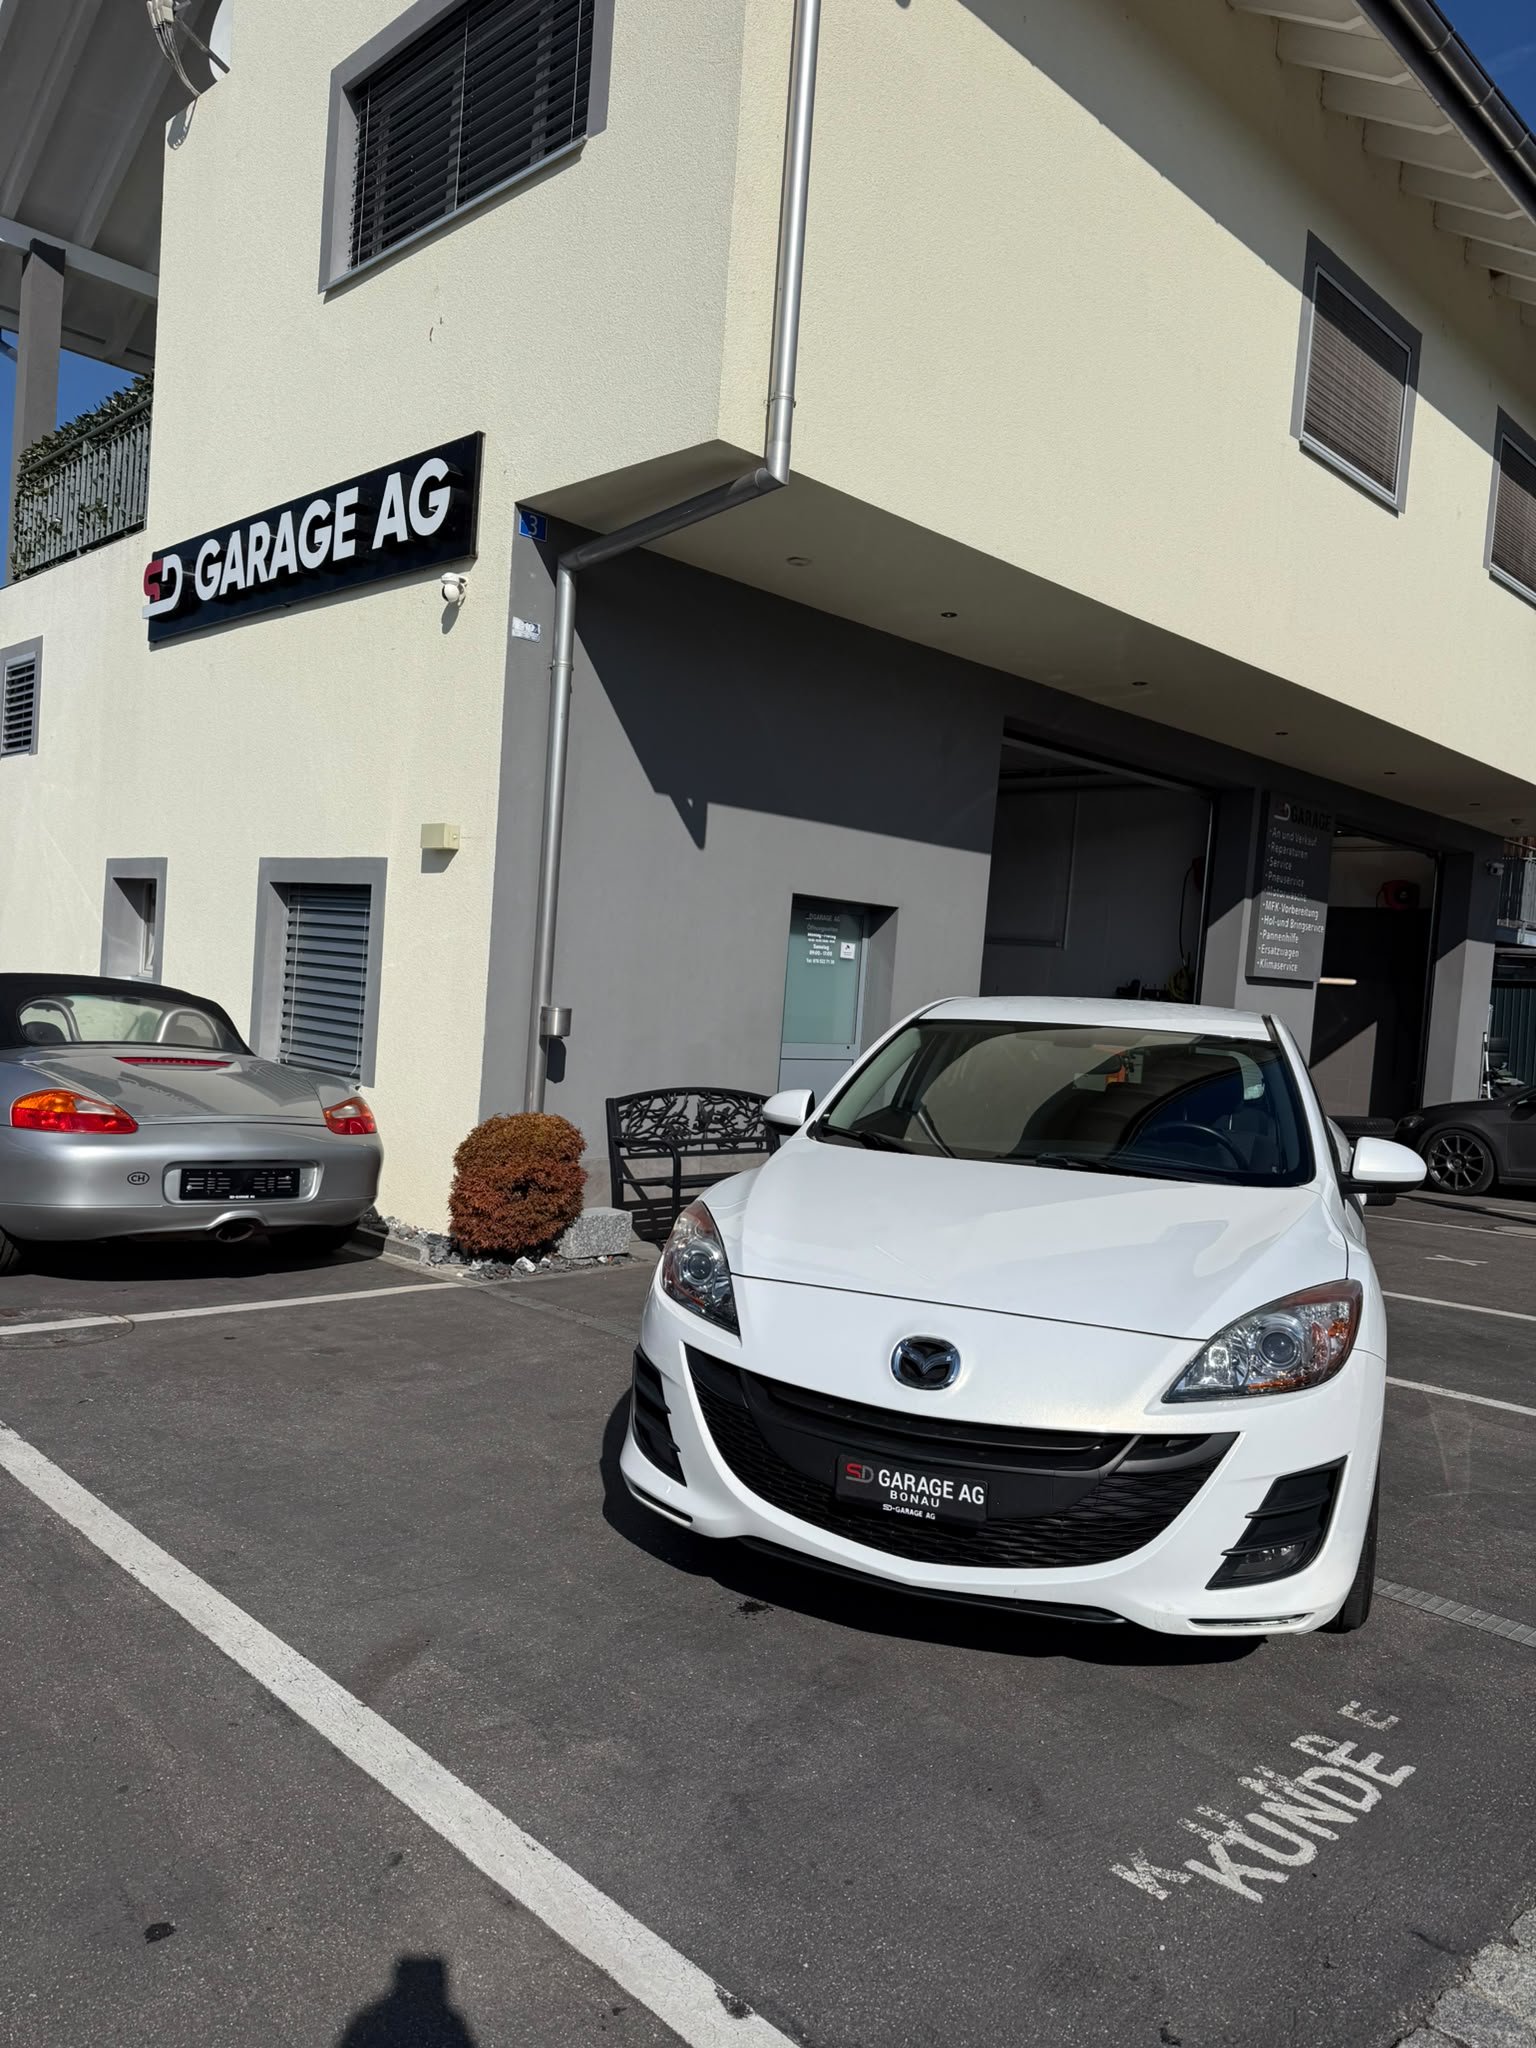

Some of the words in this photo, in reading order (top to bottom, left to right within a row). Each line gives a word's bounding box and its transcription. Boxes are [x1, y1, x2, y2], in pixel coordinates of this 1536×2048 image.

[194, 486, 359, 601] GARAGE
[372, 457, 452, 550] AG
[528, 514, 538, 536] 3
[1291, 805, 1333, 832] GARAGE
[1269, 841, 1309, 859] Reparaturen
[1268, 856, 1293, 871] Service
[1267, 870, 1305, 887] Pneuservice
[1264, 900, 1319, 921] MFK-Vorbereitung
[1290, 918, 1325, 933] Bringservice
[1261, 929, 1299, 944] Pannenhilfe
[1260, 944, 1300, 960] Ersatzwagen
[1259, 958, 1298, 972] Klimaservice
[130, 1174, 146, 1182] CH
[846, 1463, 875, 1484] SD
[878, 1469, 955, 1499] GARAGE
[958, 1483, 985, 1505] AG
[889, 1490, 940, 1508] BONAU
[882, 1503, 923, 1518] SD-GARAGE
[925, 1511, 936, 1520] AG
[1184, 1740, 1417, 1903] KUNDE
